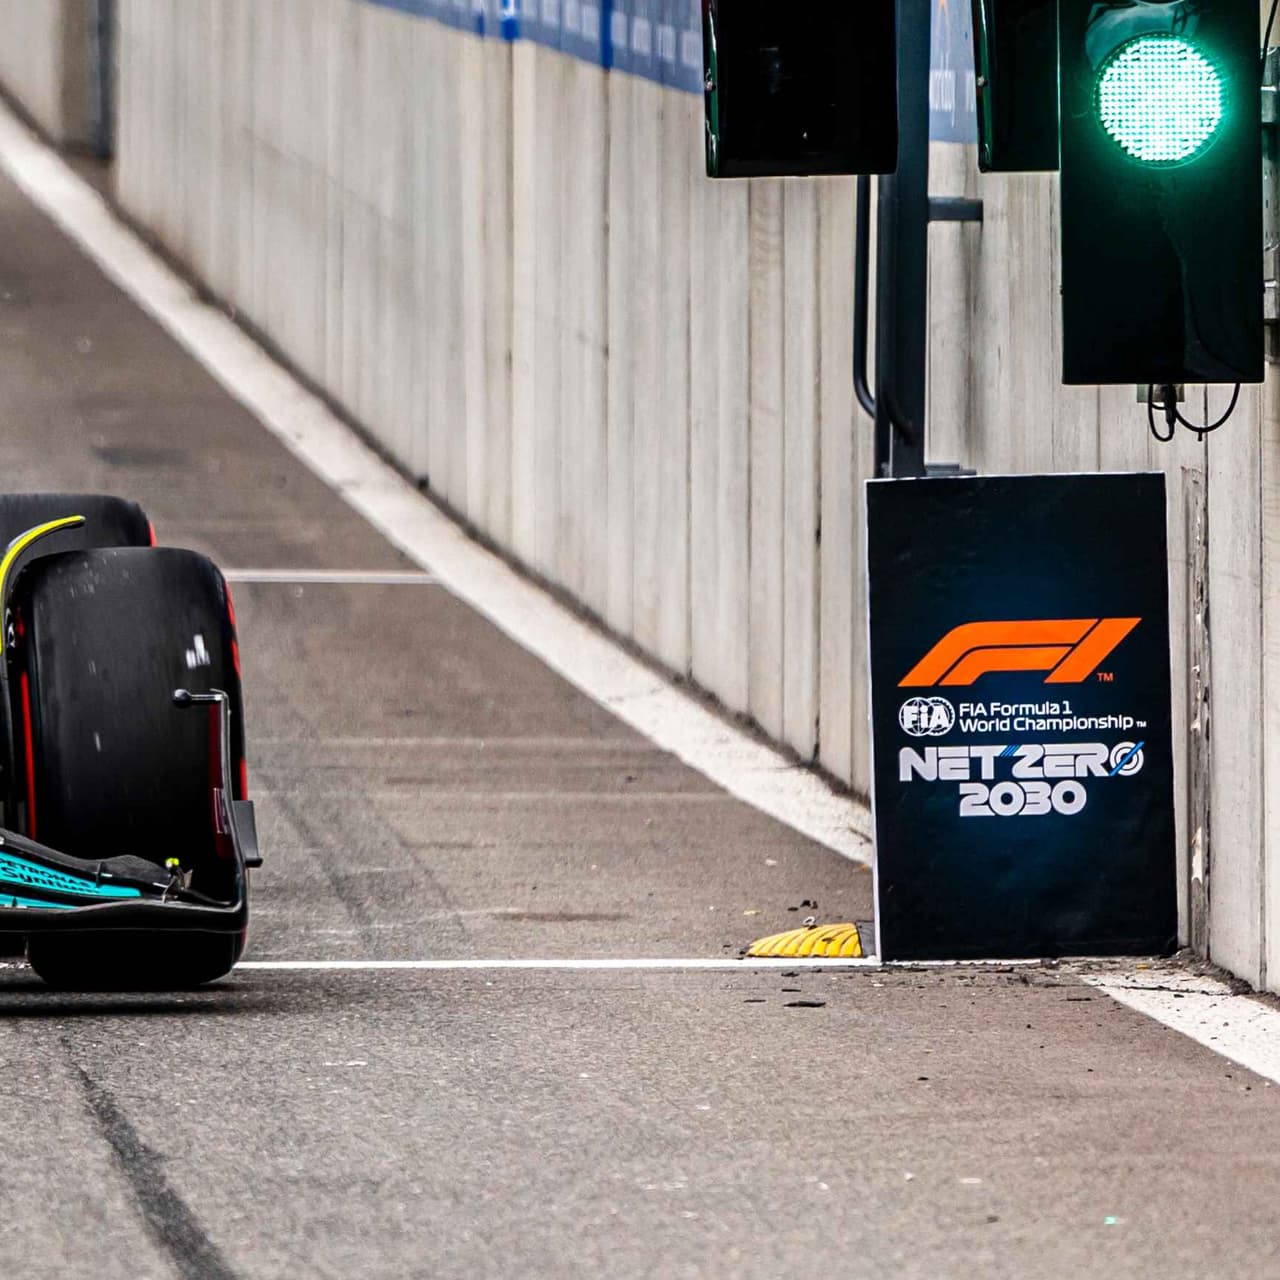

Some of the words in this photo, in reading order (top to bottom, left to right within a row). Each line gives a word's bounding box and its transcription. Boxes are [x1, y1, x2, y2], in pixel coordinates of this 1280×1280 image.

[897, 617, 1142, 687] F1
[959, 703, 988, 717] FIA
[990, 701, 1060, 716] Formula
[1062, 700, 1072, 715] 1
[959, 717, 1010, 733] World
[1013, 713, 1134, 732] Championship
[898, 743, 1007, 782] NET
[959, 779, 1088, 817] 2030
